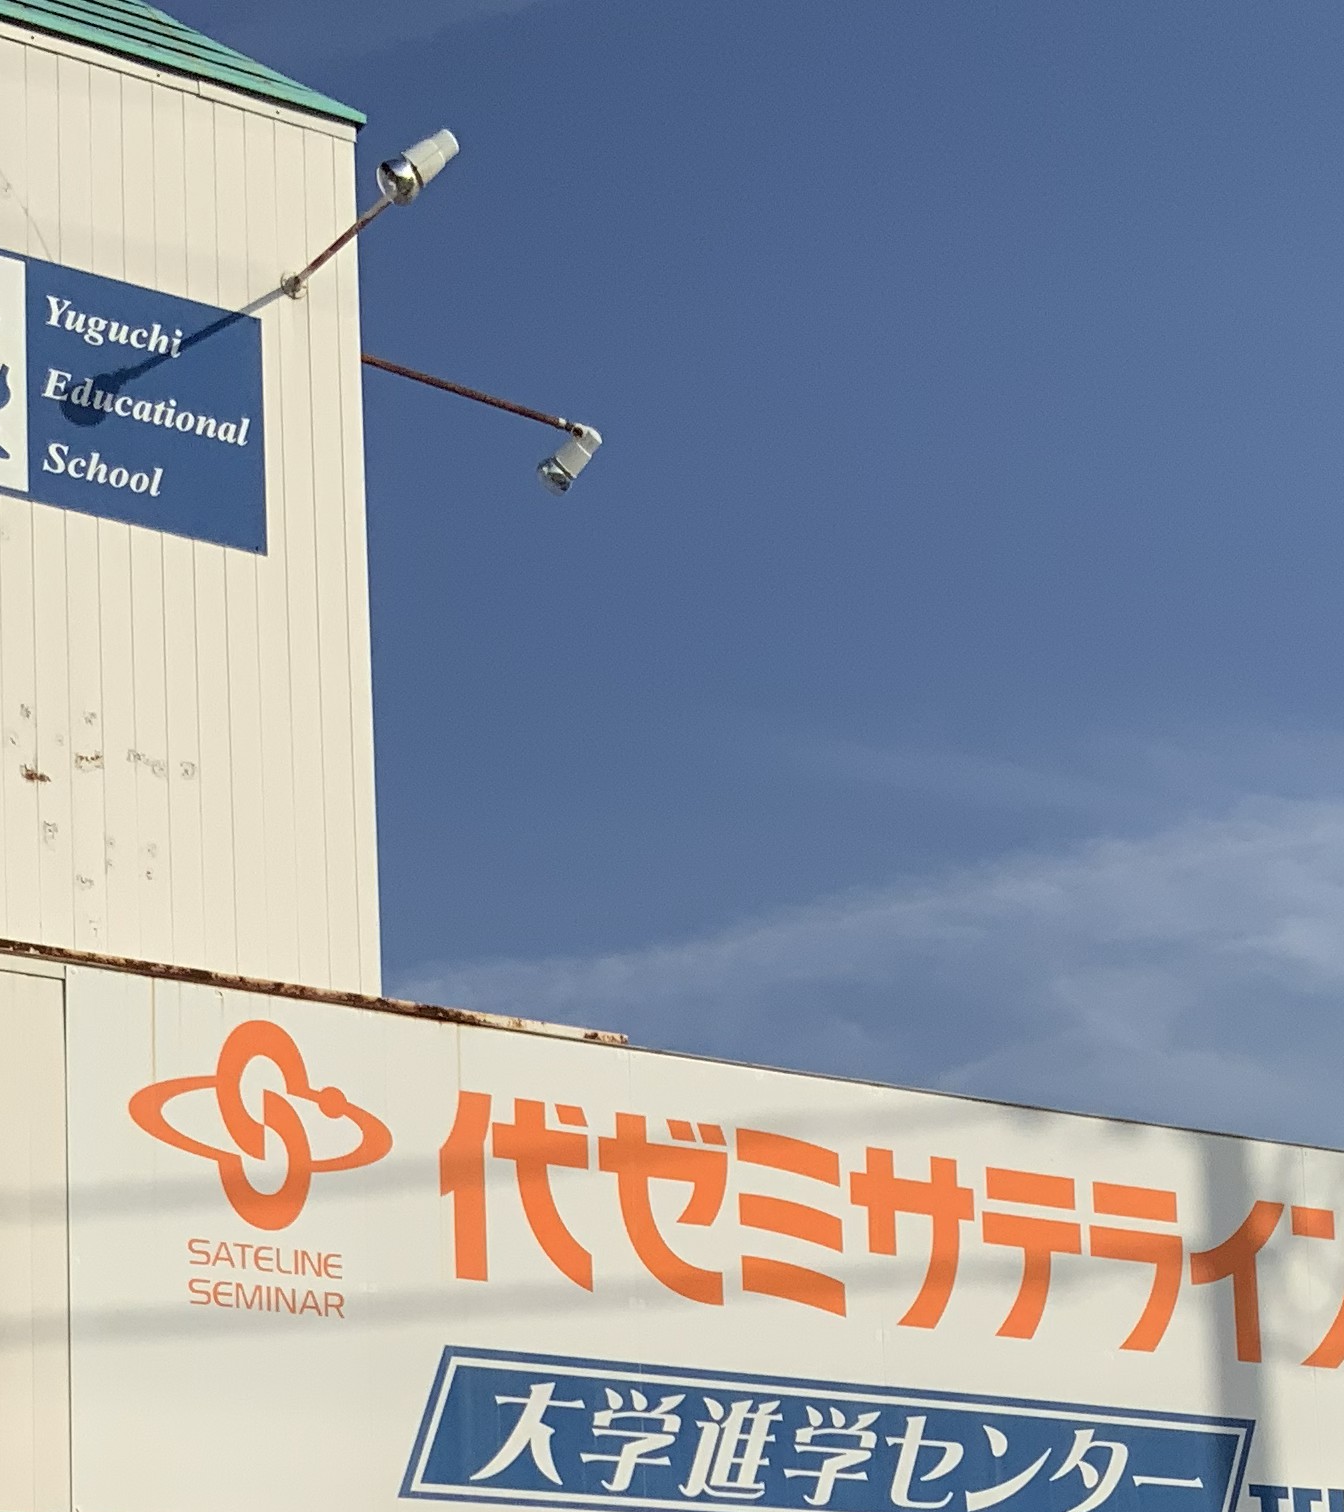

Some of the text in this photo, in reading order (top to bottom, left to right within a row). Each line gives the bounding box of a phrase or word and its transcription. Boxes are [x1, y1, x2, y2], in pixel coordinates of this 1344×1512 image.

[46, 295, 183, 358] Yuguchi
[42, 368, 250, 446] Educational
[43, 442, 163, 497] School
[187, 1238, 343, 1280] SATELINE
[188, 1278, 345, 1319] SEMINAR
